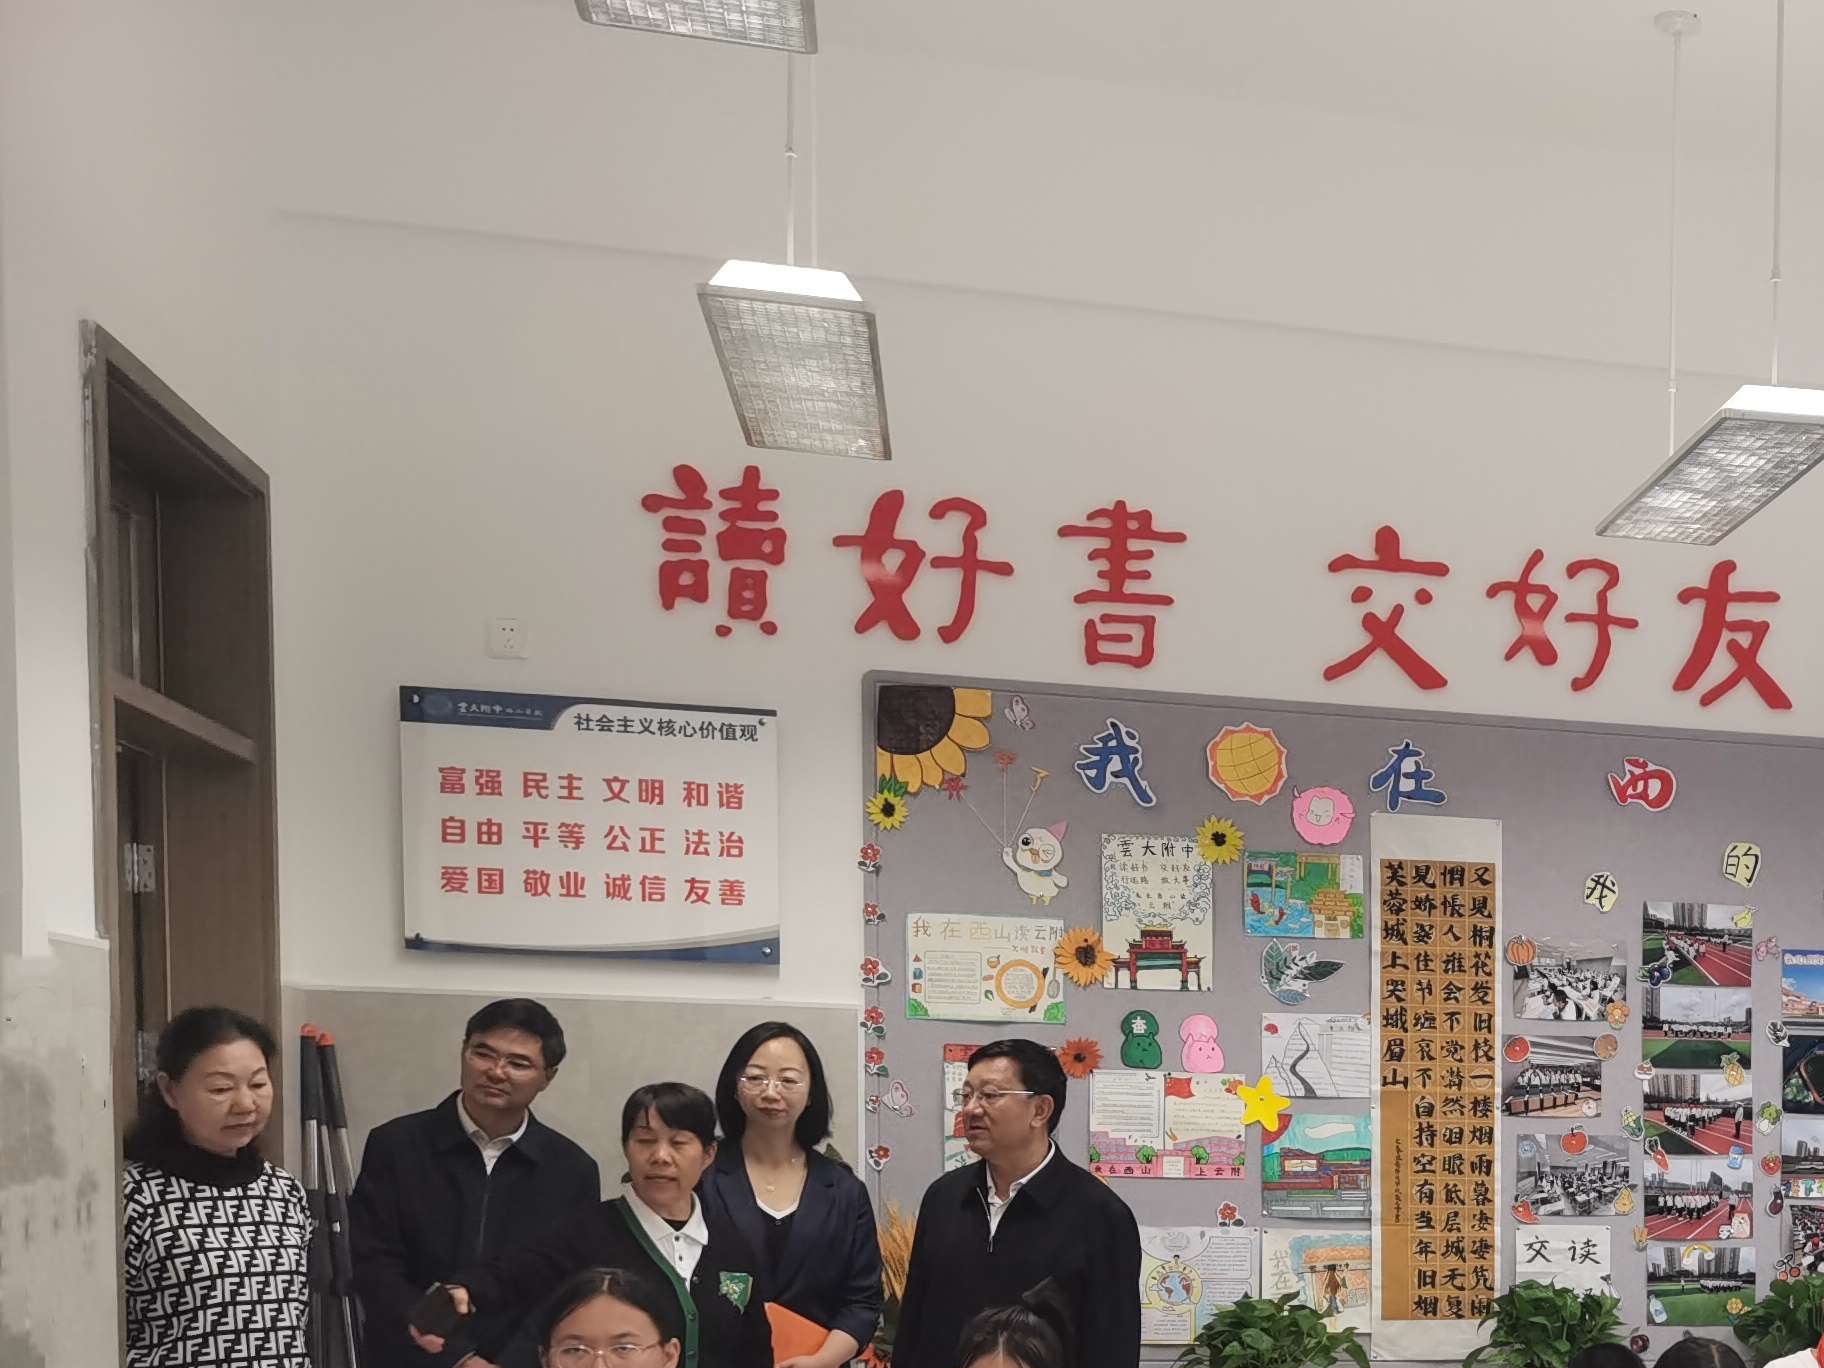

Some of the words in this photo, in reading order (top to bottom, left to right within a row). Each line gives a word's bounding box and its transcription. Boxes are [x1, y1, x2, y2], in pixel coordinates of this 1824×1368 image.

[1324, 527, 1792, 710] 交好友
[574, 713, 759, 742] 社会主义核心价值观
[438, 767, 503, 797] 富强
[522, 771, 584, 801] 民主
[602, 776, 664, 805] 文明
[683, 781, 744, 809] 和谐
[440, 816, 503, 845] 自由
[522, 821, 585, 850] 平等
[604, 825, 665, 854] 公正
[684, 829, 744, 858] 法治
[440, 866, 504, 895] 爱国
[523, 869, 585, 898] 敬业
[604, 873, 666, 902] 诚信
[684, 877, 745, 906] 友善
